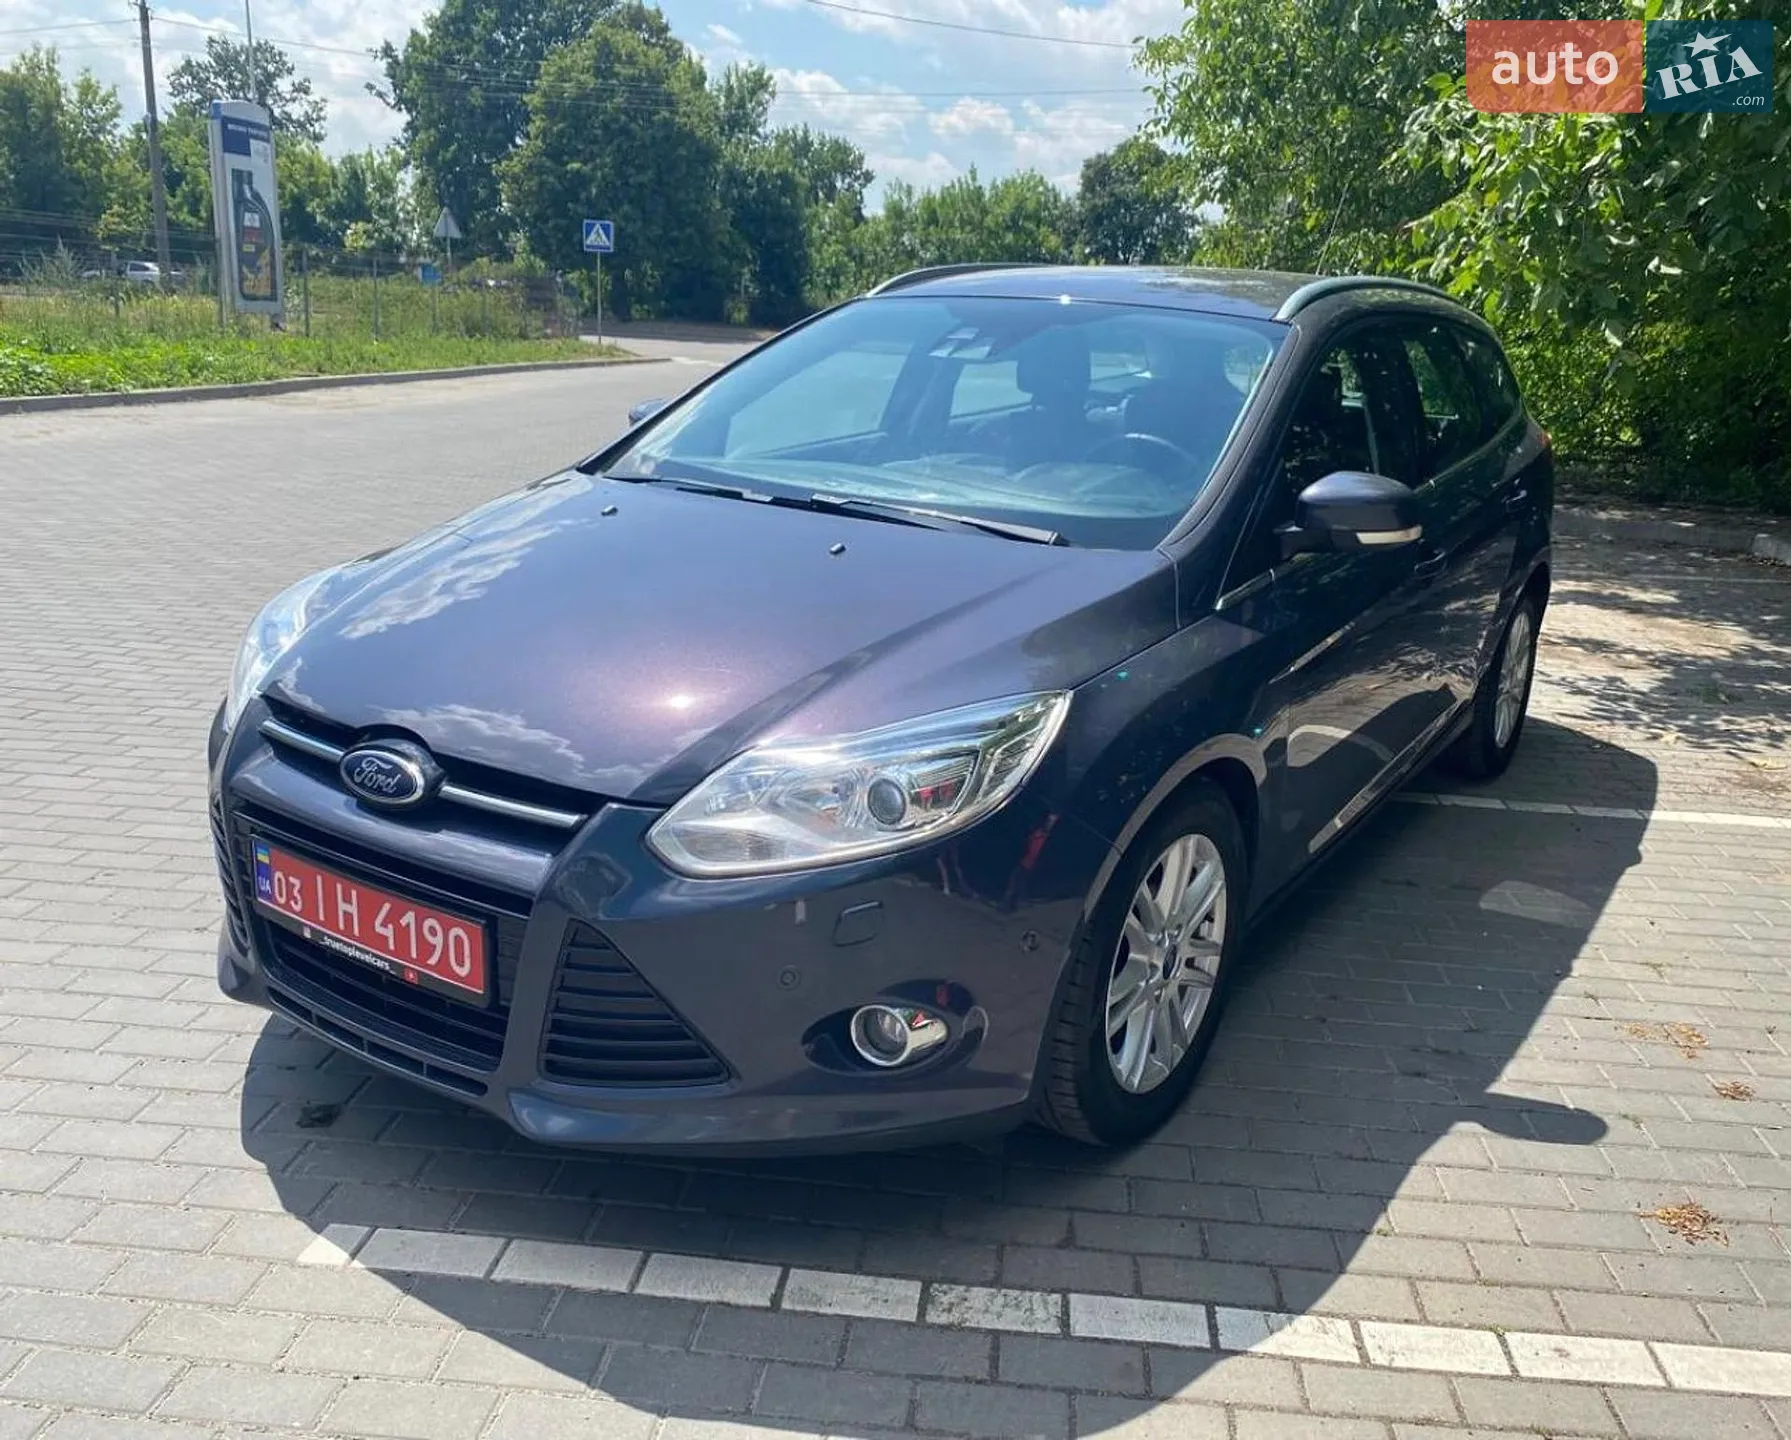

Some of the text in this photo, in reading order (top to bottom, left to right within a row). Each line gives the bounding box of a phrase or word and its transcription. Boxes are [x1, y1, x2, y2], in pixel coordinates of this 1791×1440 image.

[354, 756, 402, 794] Ford
[258, 876, 272, 894] UA
[273, 871, 301, 912] 03
[374, 902, 472, 977] 4190
